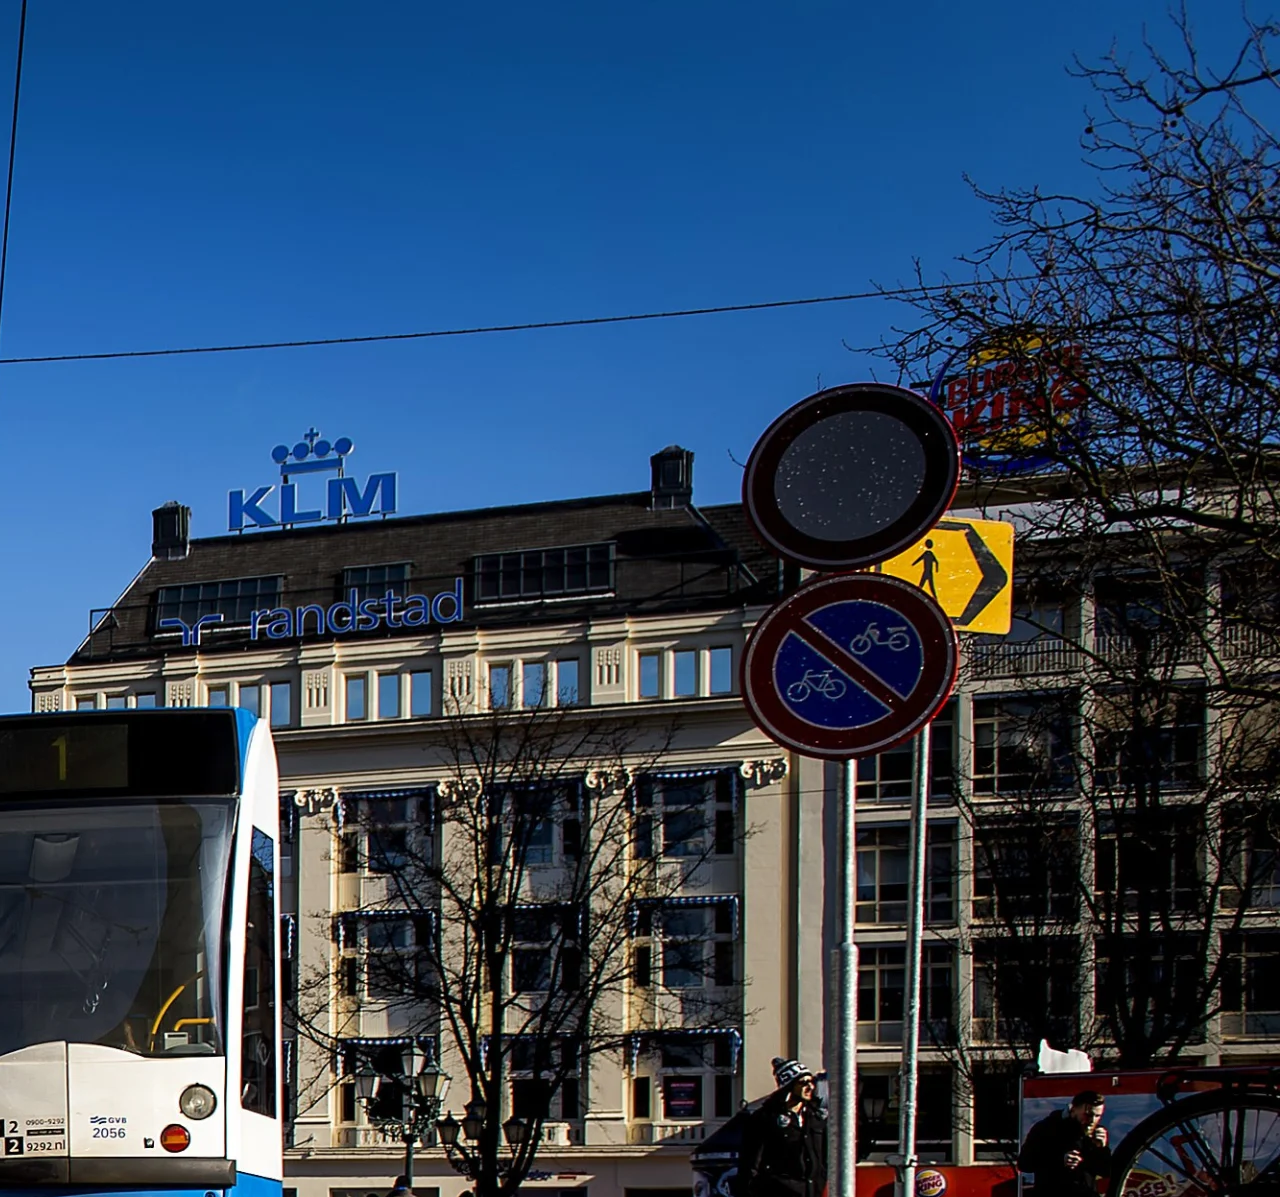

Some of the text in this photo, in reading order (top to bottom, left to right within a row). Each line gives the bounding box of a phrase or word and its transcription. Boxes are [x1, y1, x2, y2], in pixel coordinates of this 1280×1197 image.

[228, 471, 398, 532] KLM
[250, 577, 464, 640] randstad
[51, 734, 67, 781] 1
[92, 1127, 126, 1139] 2056
[108, 1116, 127, 1124] GVB
[26, 1139, 66, 1152] 9292.nl
